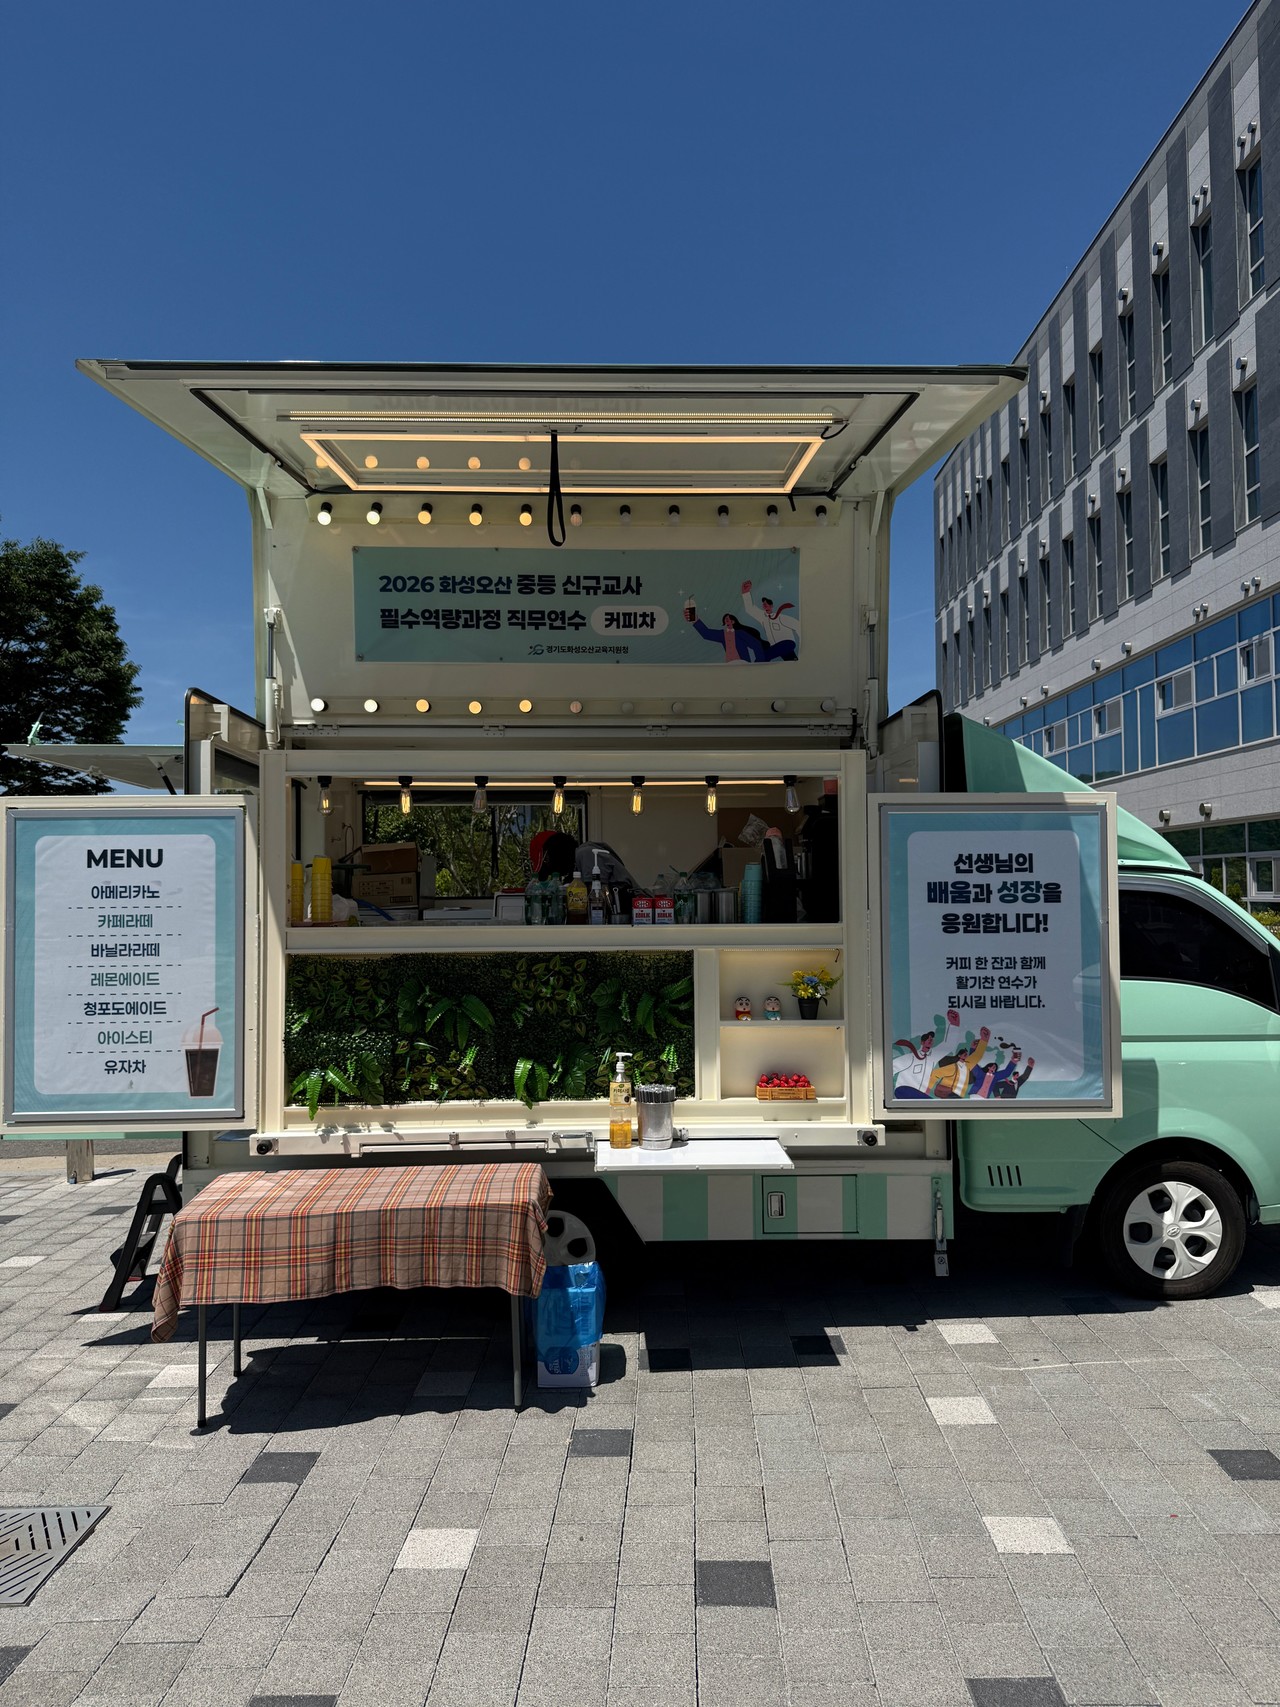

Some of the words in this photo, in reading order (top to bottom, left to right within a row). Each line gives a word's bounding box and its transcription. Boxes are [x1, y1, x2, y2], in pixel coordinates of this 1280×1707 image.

[379, 576, 434, 592] 2026
[439, 576, 512, 594] 화성오산
[517, 575, 556, 595] 중등
[562, 576, 642, 595] 신규교사
[380, 608, 501, 629] 필수역량과정
[508, 610, 586, 630] 직무연수
[605, 612, 656, 629] 커피차
[546, 645, 629, 655] 경기도화성오산교육지원청
[87, 849, 163, 868] MENU
[954, 853, 1033, 873] 선생님의
[91, 885, 160, 899] 아메리카노
[927, 881, 992, 903] 배움과
[998, 881, 1062, 903] 성장을
[98, 914, 152, 928] 카페라떼
[942, 913, 1048, 934] 응원합니다!
[92, 943, 159, 957] 바닐라라떼
[946, 957, 971, 970] 커피
[975, 957, 988, 970] 한
[991, 957, 1017, 970] 잔과
[1020, 956, 1045, 969] 함께
[91, 972, 159, 986] 레몬에이드
[956, 976, 995, 989] 활기찬
[998, 976, 1037, 989] 연수가
[84, 1001, 166, 1016] 청포도에이드
[947, 995, 986, 1009] 되시길
[991, 995, 1045, 1008] 바랍니다.
[98, 1031, 152, 1045] 아이스티
[104, 1060, 146, 1074] 유자차
